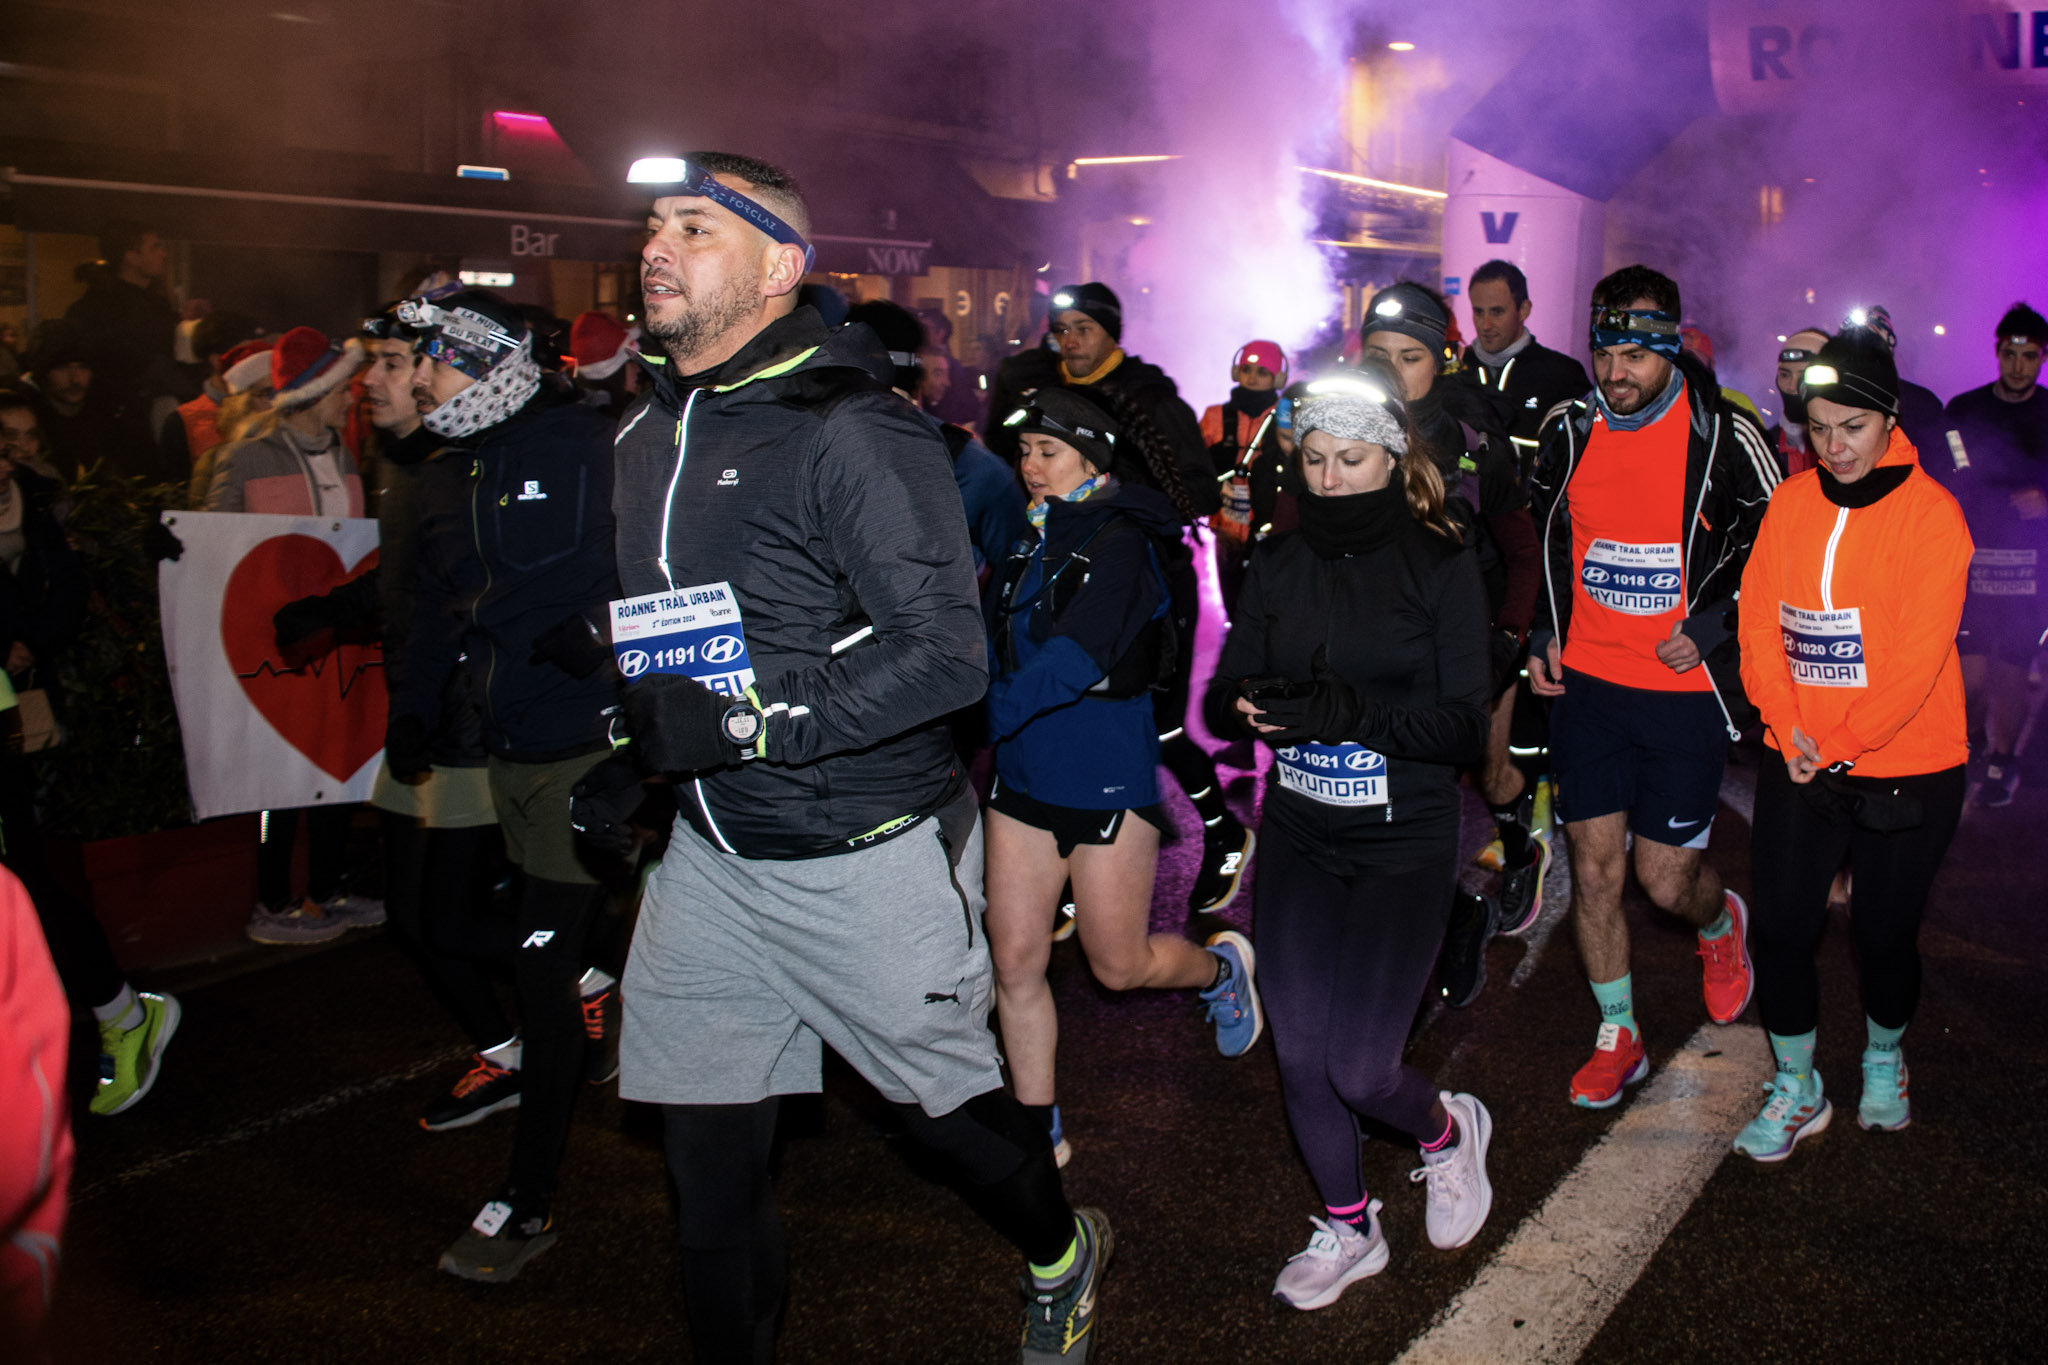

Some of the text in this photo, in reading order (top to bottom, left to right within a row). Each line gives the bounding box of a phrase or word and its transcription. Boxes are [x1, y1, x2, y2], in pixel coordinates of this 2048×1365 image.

[729, 196, 777, 231] FORCLAZ
[511, 224, 560, 256] Bar
[866, 247, 924, 274] NOW
[460, 309, 501, 332] LA NUIT
[448, 326, 495, 348] DU PILAT
[1619, 545, 1642, 554] TRAIL
[1644, 546, 1675, 555] URBAIN
[1613, 573, 1646, 587] 1018
[618, 589, 727, 619] ROANNE TRAIL URBAIN
[1588, 587, 1673, 609] HYUNDAI
[1798, 610, 1818, 622] TRAIL
[1819, 612, 1852, 622] URBAIN
[655, 645, 695, 668] 1191
[1797, 641, 1827, 656] 1020
[1303, 751, 1339, 769] 1021
[1282, 765, 1377, 797] HYUNDAI
